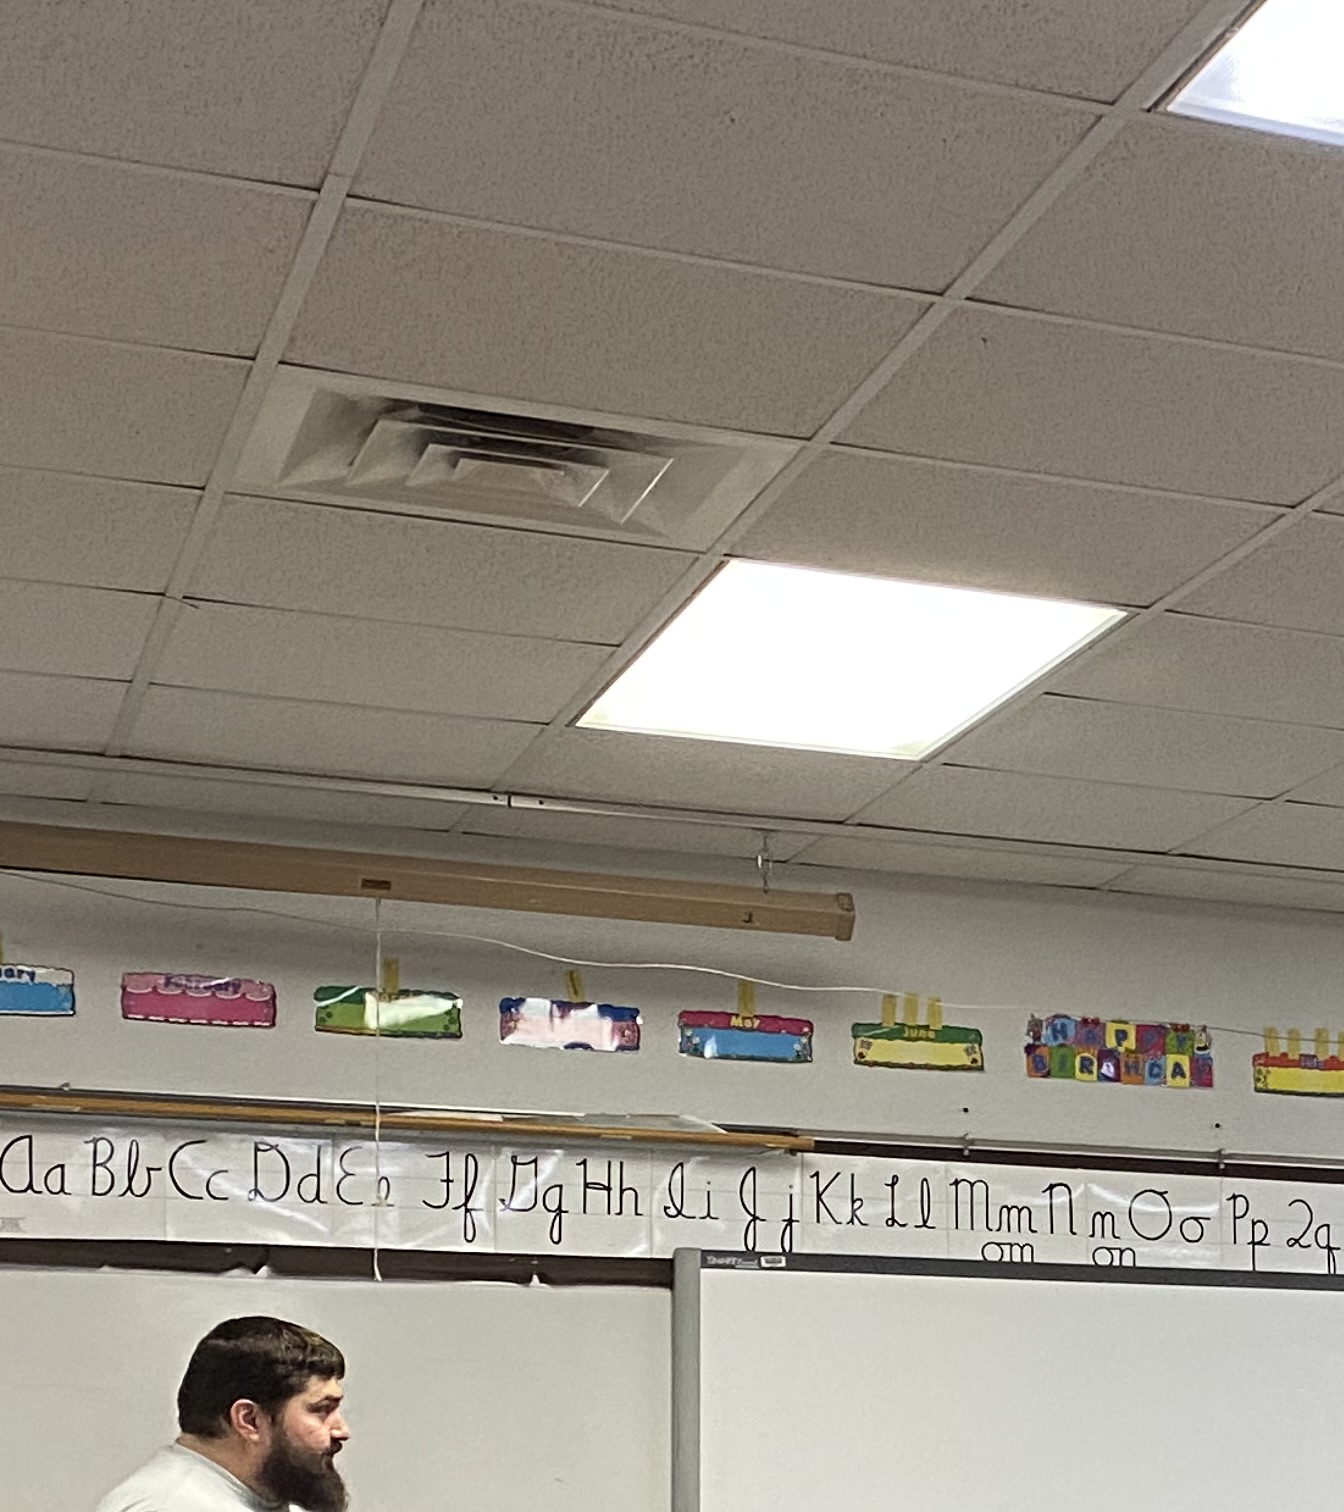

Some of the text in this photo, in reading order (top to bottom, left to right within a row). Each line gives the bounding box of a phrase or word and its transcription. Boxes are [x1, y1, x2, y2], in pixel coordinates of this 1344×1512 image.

[729, 1015, 759, 1030] May
[903, 1026, 936, 1040] June
[1052, 1021, 1188, 1050] HAPPY
